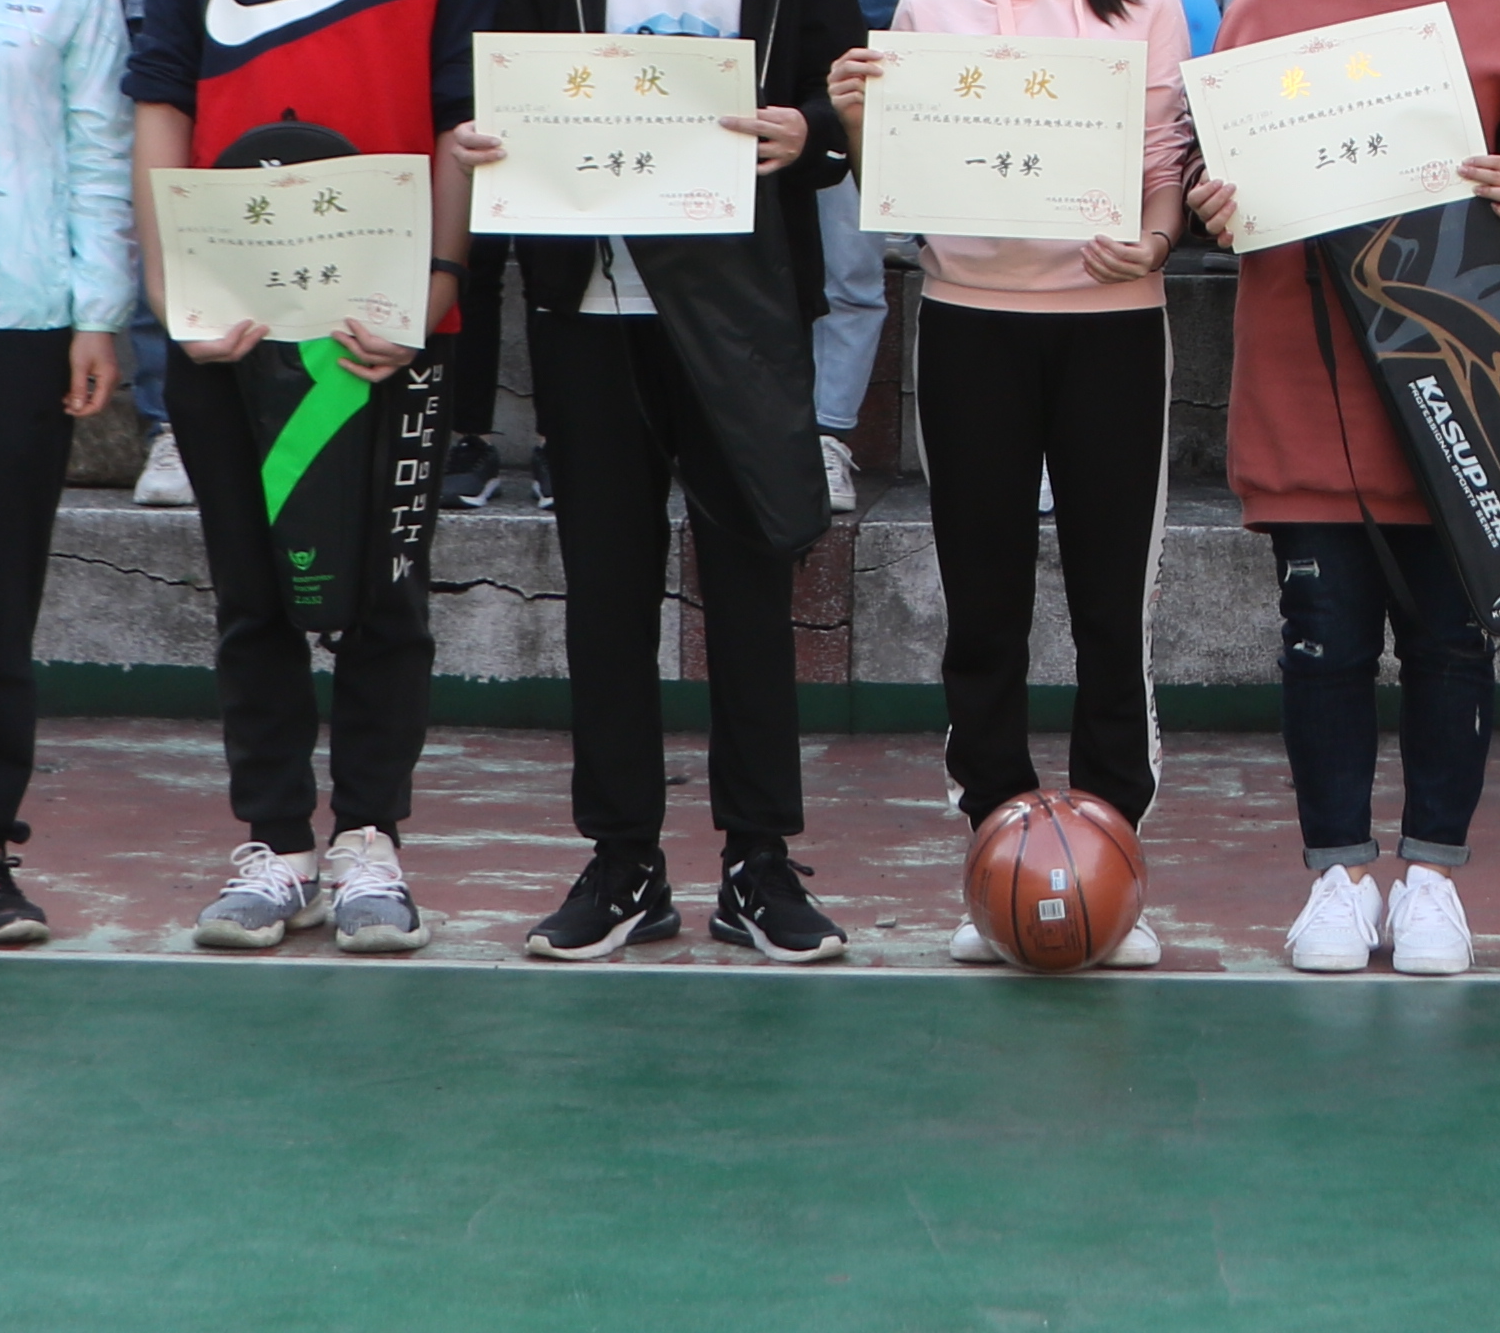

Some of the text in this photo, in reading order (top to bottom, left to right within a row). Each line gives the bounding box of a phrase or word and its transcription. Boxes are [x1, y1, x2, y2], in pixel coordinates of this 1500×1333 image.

[563, 65, 669, 99] 奖状
[954, 66, 1058, 99] 奖状
[576, 150, 656, 178] 二等奖
[964, 151, 1043, 178] 一等奖
[1315, 133, 1388, 169] 三等奖
[243, 187, 348, 226] 奖状
[266, 264, 342, 290] 三等奖
[1415, 374, 1490, 488] KASUP
[1408, 381, 1499, 549] PROFESSIONAL SPORTS SERIES
